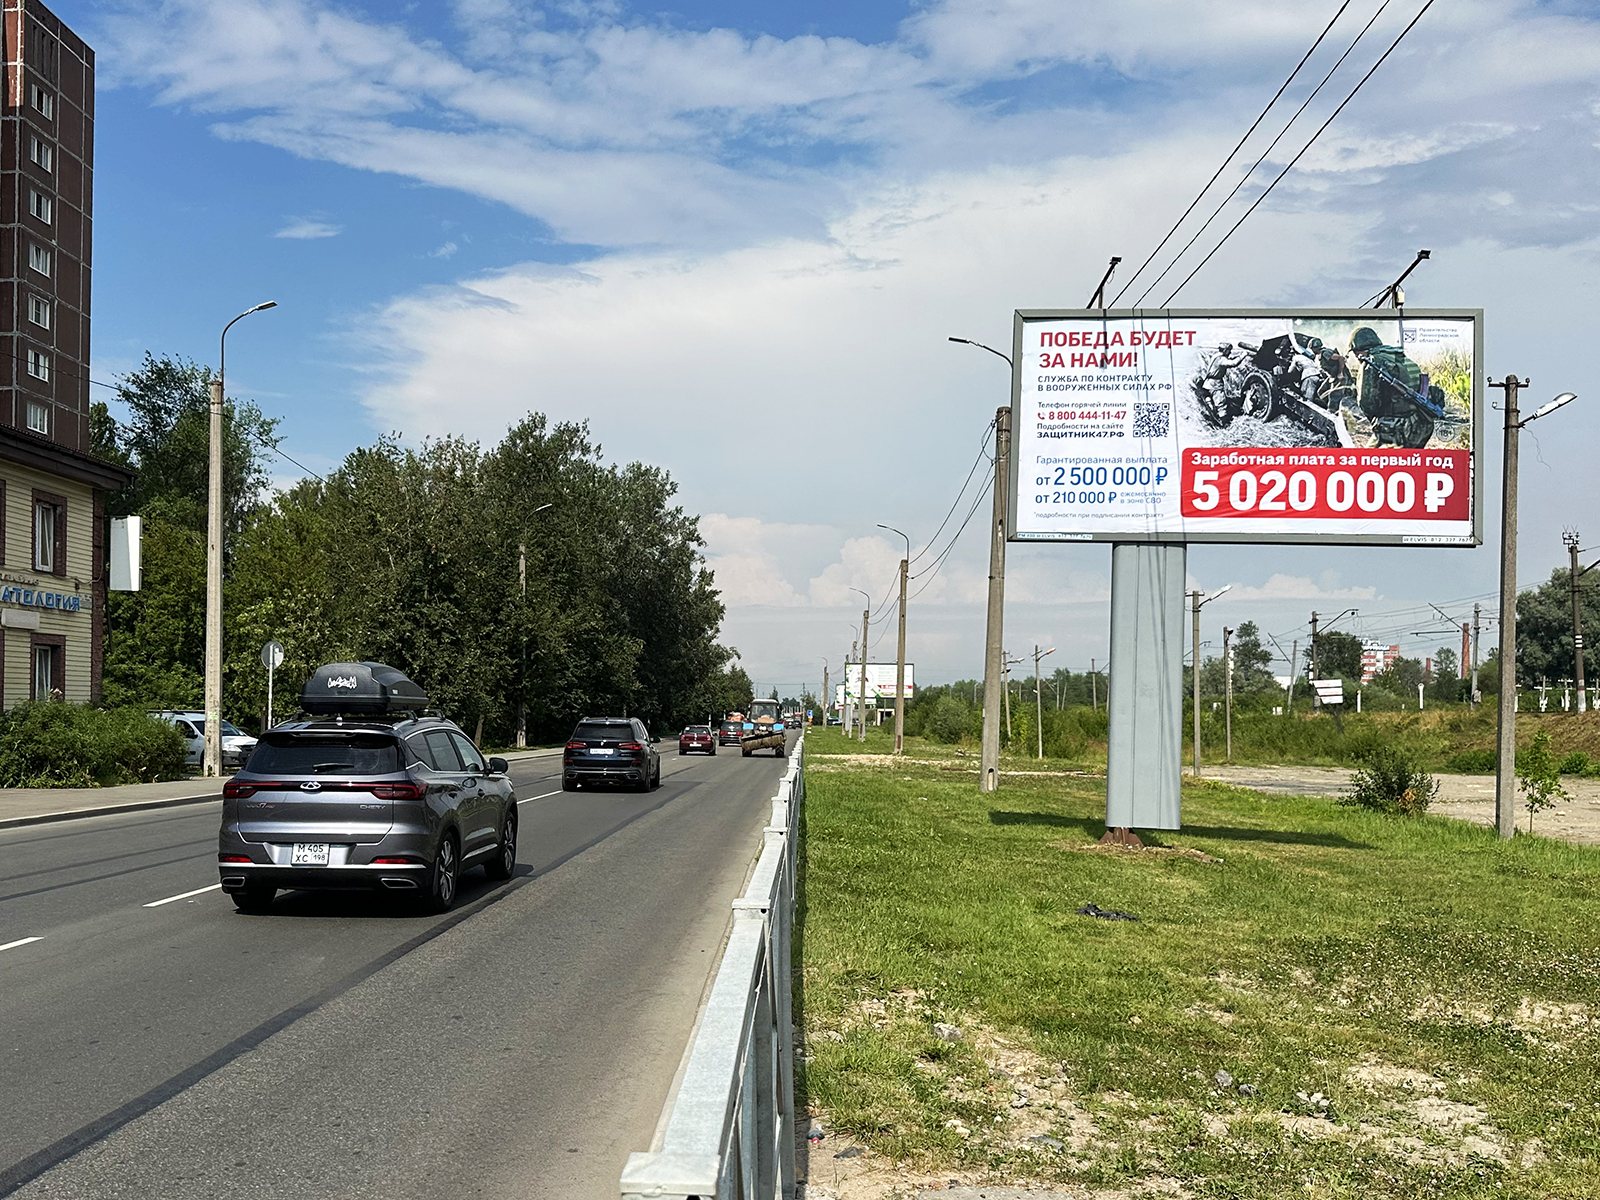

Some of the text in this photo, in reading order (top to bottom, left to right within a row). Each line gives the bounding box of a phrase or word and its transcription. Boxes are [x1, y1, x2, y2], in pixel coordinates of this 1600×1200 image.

[1040, 331, 1197, 349] ПОБЕДА БУДЕТ
[1039, 352, 1138, 368] ЗА НАМИ!
[1038, 375, 1078, 383] СЛУЖБА
[1038, 384, 1043, 392] В
[1046, 384, 1120, 392] ВООРУЖЕННЫХ
[1049, 411, 1127, 420] 8 800 444-11-47
[1036, 456, 1122, 465] Гарантированная
[1192, 452, 1454, 469] Заработная плата за первый год
[1036, 477, 1050, 486] от
[1054, 466, 1066, 486] 2
[1070, 466, 1107, 486] 500
[1113, 466, 1150, 486] 000
[1192, 471, 1220, 511] 5
[1229, 471, 1317, 512] 020
[1326, 472, 1416, 512] 000
[1036, 495, 1050, 504] от
[1052, 492, 1076, 504] 210
[1078, 492, 1105, 504] 000
[2, 587, 80, 611] АТОЛОГИЯ
[298, 844, 324, 852] М 405
[295, 854, 308, 862] ХС
